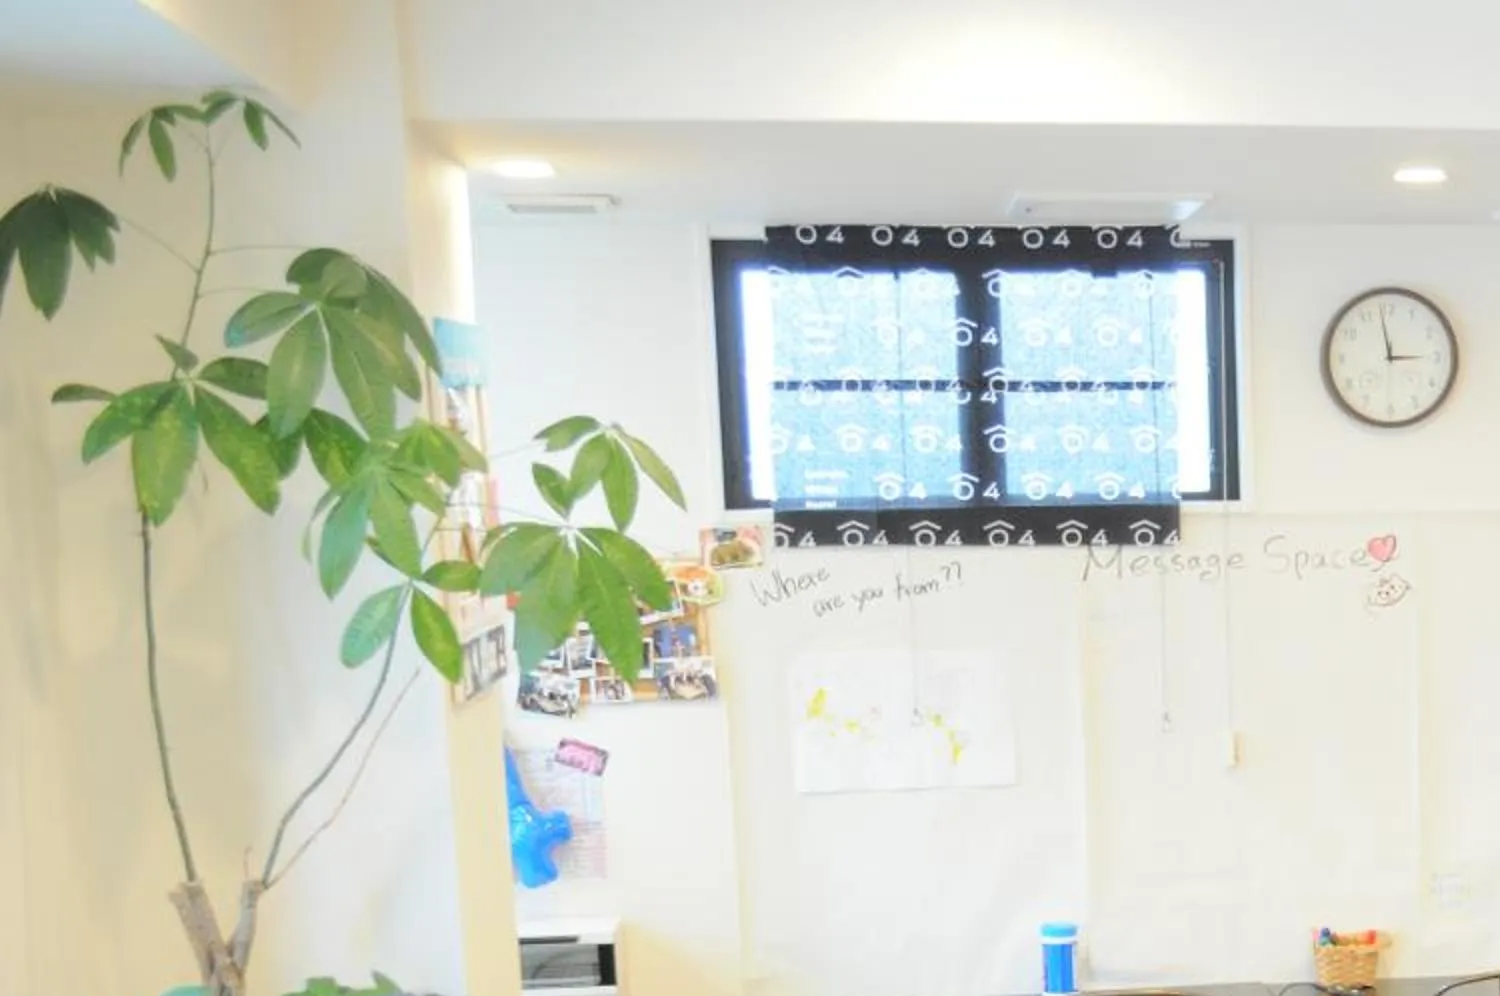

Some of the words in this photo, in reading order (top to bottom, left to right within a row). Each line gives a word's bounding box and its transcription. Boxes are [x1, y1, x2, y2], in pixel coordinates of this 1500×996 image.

[1082, 544, 1246, 583] Message
[1262, 534, 1368, 581] Space
[750, 566, 831, 607] Where
[812, 592, 845, 617] are
[851, 585, 884, 612] you
